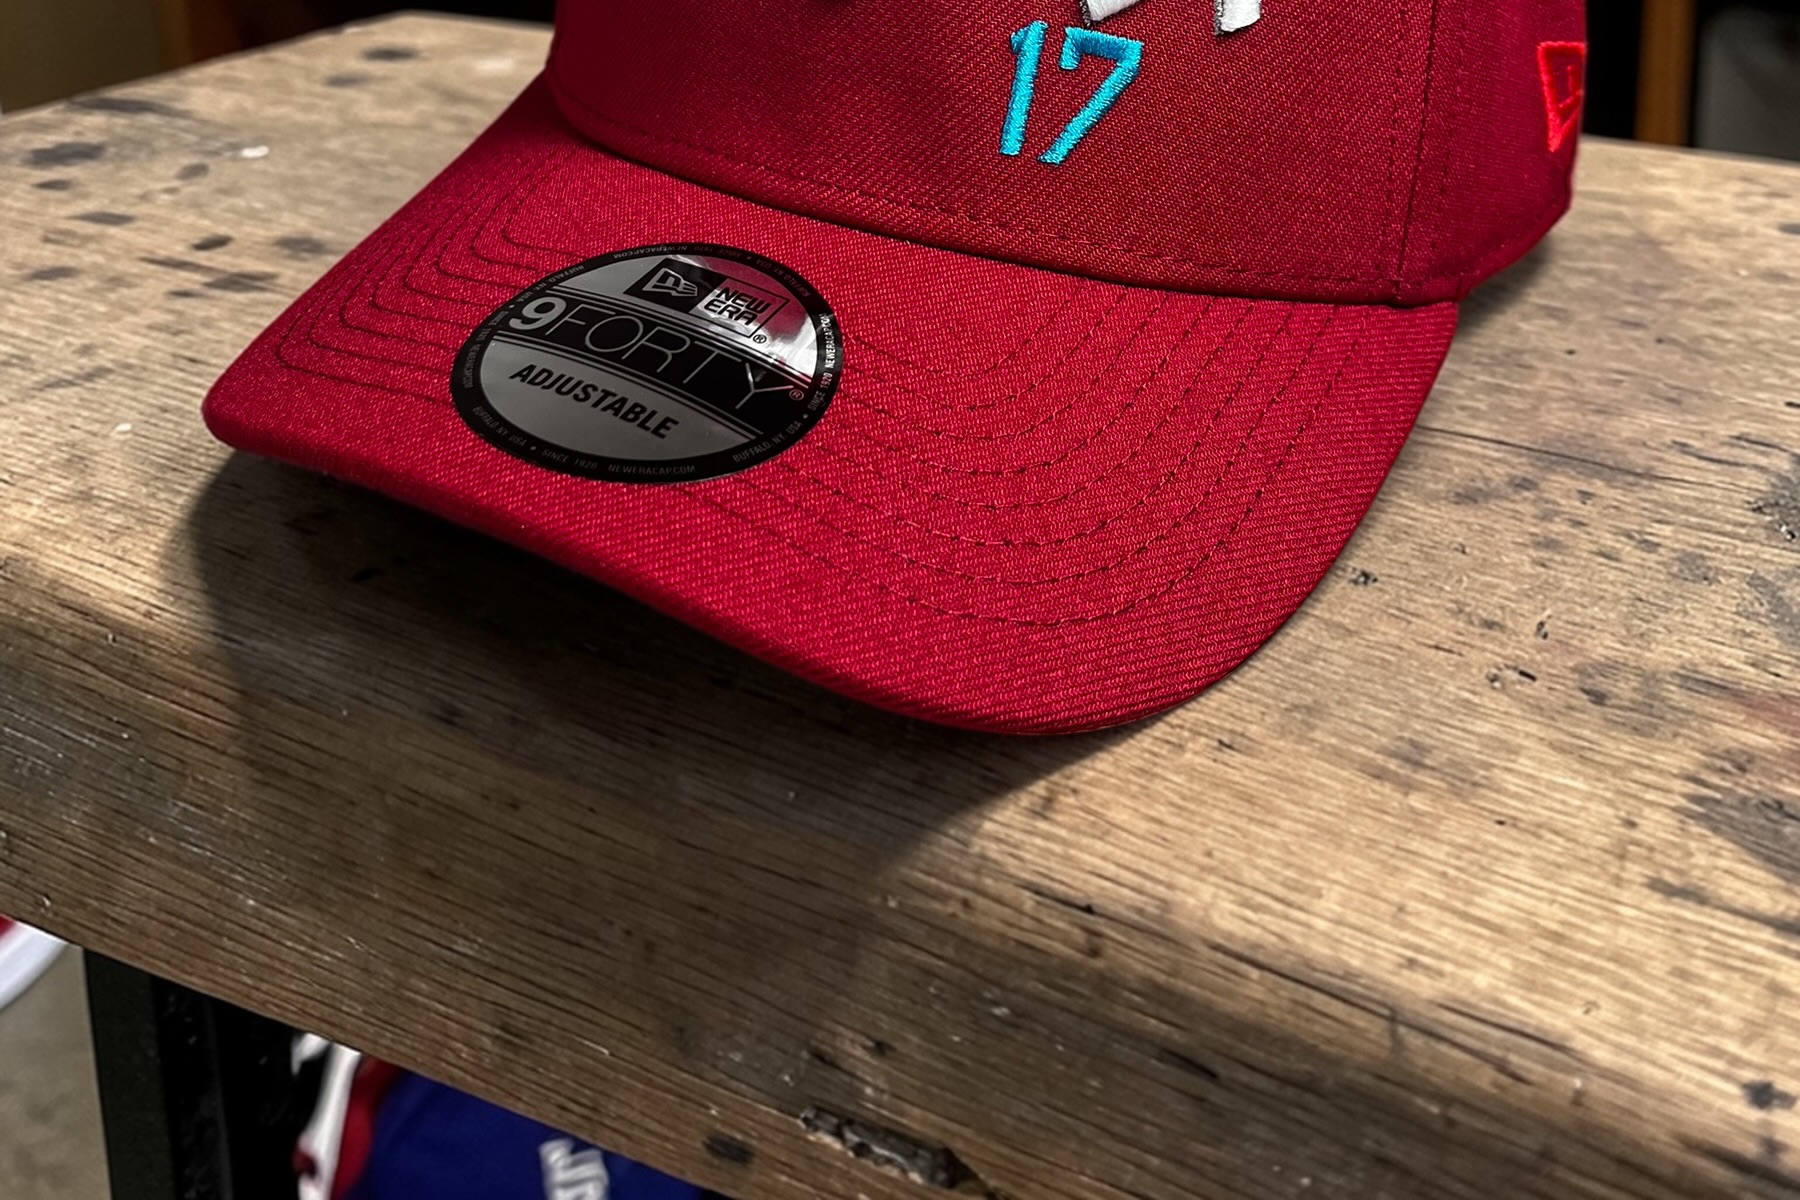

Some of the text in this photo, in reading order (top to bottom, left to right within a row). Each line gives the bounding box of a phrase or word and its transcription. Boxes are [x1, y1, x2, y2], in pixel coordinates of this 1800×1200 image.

[1001, 20, 1143, 166] 17
[704, 298, 758, 326] ERA
[716, 287, 772, 314] NEW
[509, 296, 795, 410] 9FORTY
[508, 364, 680, 440] ADJUSTABLE
[785, 420, 803, 435] USA
[541, 448, 571, 463] SINCE
[574, 457, 599, 470] 1920
